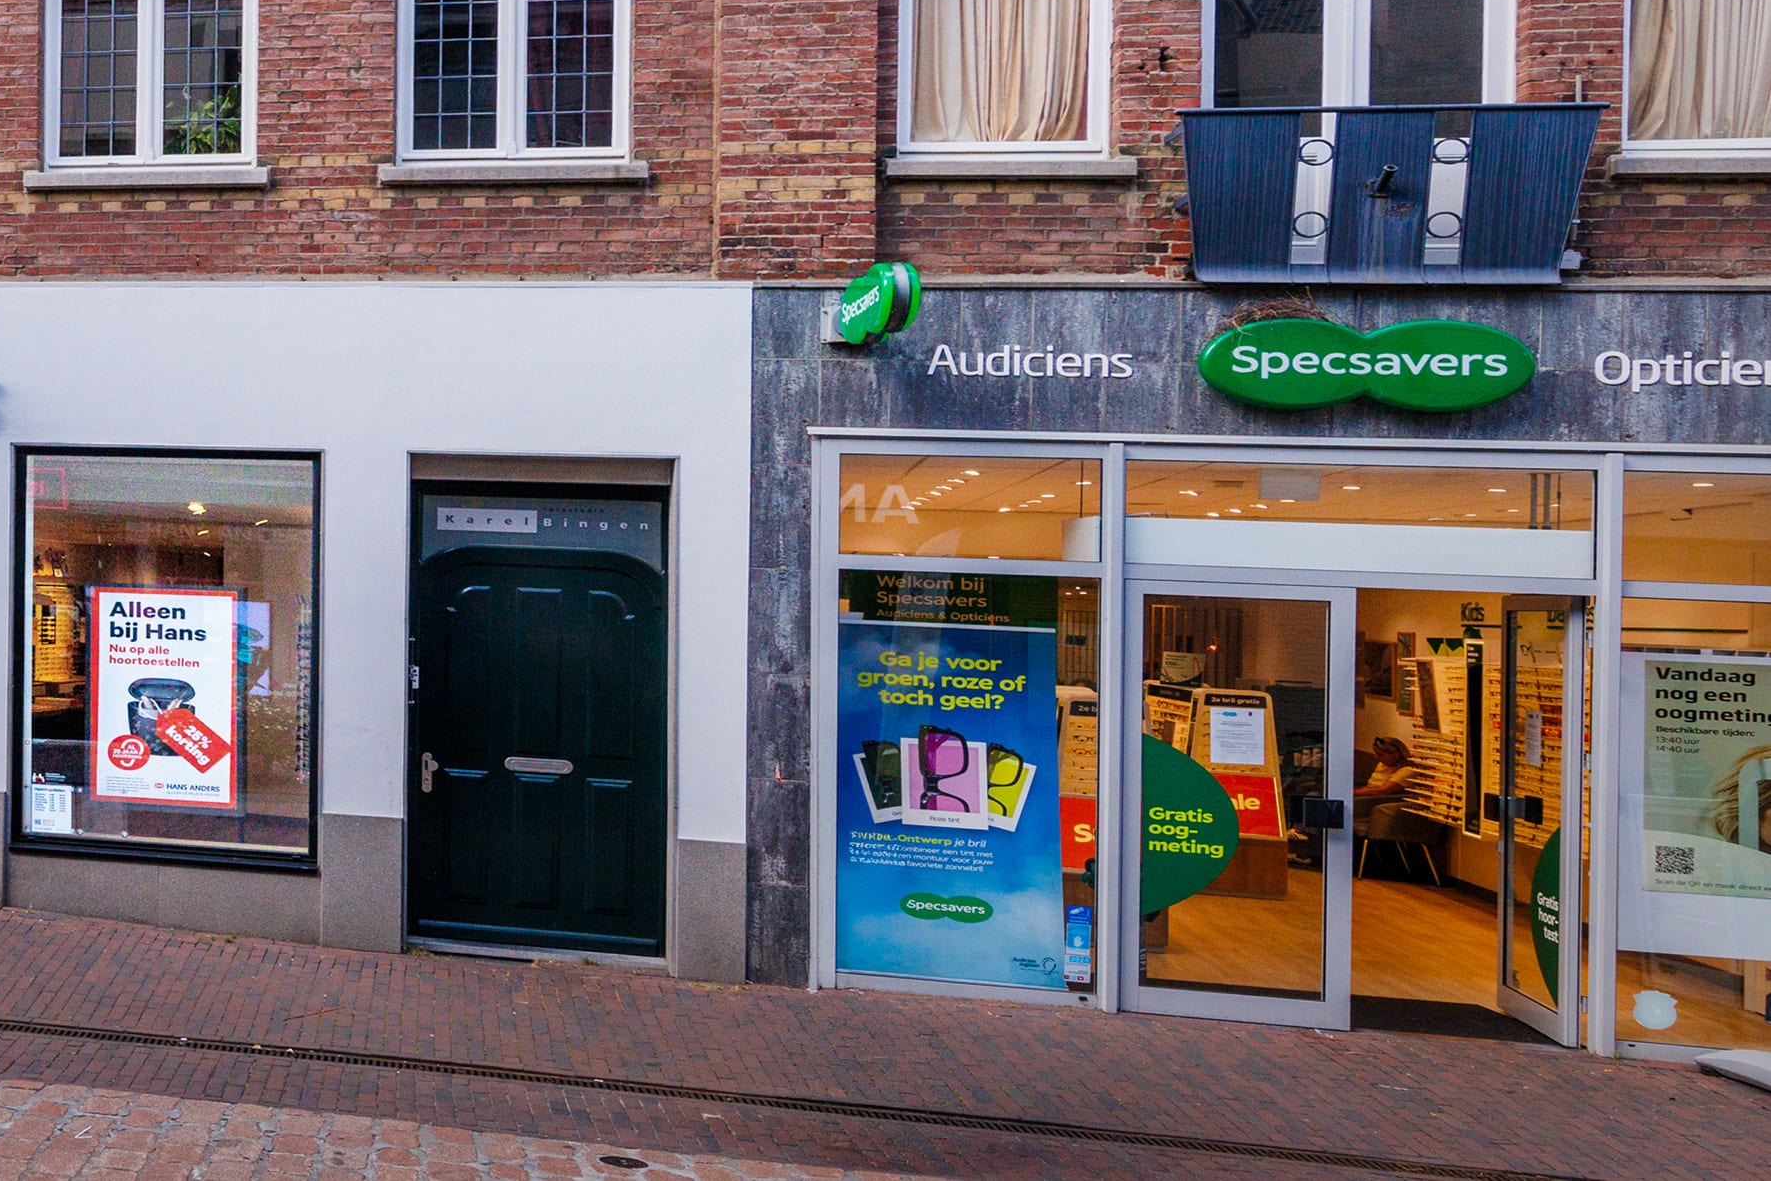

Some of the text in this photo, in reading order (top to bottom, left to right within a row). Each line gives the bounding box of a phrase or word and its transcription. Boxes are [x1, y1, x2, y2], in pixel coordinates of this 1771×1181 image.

[842, 285, 880, 325] Specsavers
[927, 344, 1133, 379] Audiciens
[1231, 345, 1509, 380] Specsavers
[445, 514, 648, 531] Karel Bingen
[876, 575, 985, 594] Welkom bij
[876, 591, 988, 607] Specsavers
[109, 601, 186, 620] Alleen
[876, 609, 1009, 623] Audiciens & Opticiens
[110, 621, 207, 642] bij Hans
[109, 644, 170, 657] Nu op alle
[109, 655, 200, 668] hoortoestellen
[880, 651, 1003, 672] Ga je voor
[857, 671, 1027, 692] groen, roze of
[1655, 666, 1756, 687] Vandaag
[879, 690, 1005, 711] toch geel?
[1236, 698, 1261, 707] gratis
[1655, 687, 1747, 703] nog een
[1078, 704, 1090, 713] 2e
[183, 725, 213, 749] 25%
[1656, 725, 1756, 738] Beschikbare tijden:
[1656, 735, 1700, 745] 13:40 uur
[165, 724, 211, 766] korting
[1656, 744, 1700, 754] 14:40 uur
[166, 783, 220, 793] HANS ANDERS
[1230, 793, 1261, 811] le
[1148, 807, 1213, 824] Gratis
[1148, 823, 1198, 839] oog-
[898, 834, 987, 848] Ontwerp je bril
[1148, 840, 1224, 858] meting
[913, 853, 949, 862] montuur
[972, 857, 994, 866] jouw
[960, 849, 974, 857] tint
[977, 850, 993, 858] met
[907, 861, 984, 872] favoriete zonnebril
[906, 899, 986, 915] Specsavers
[1536, 892, 1559, 912] Gratis
[1538, 907, 1559, 926] hoor-
[1543, 926, 1559, 943] test
